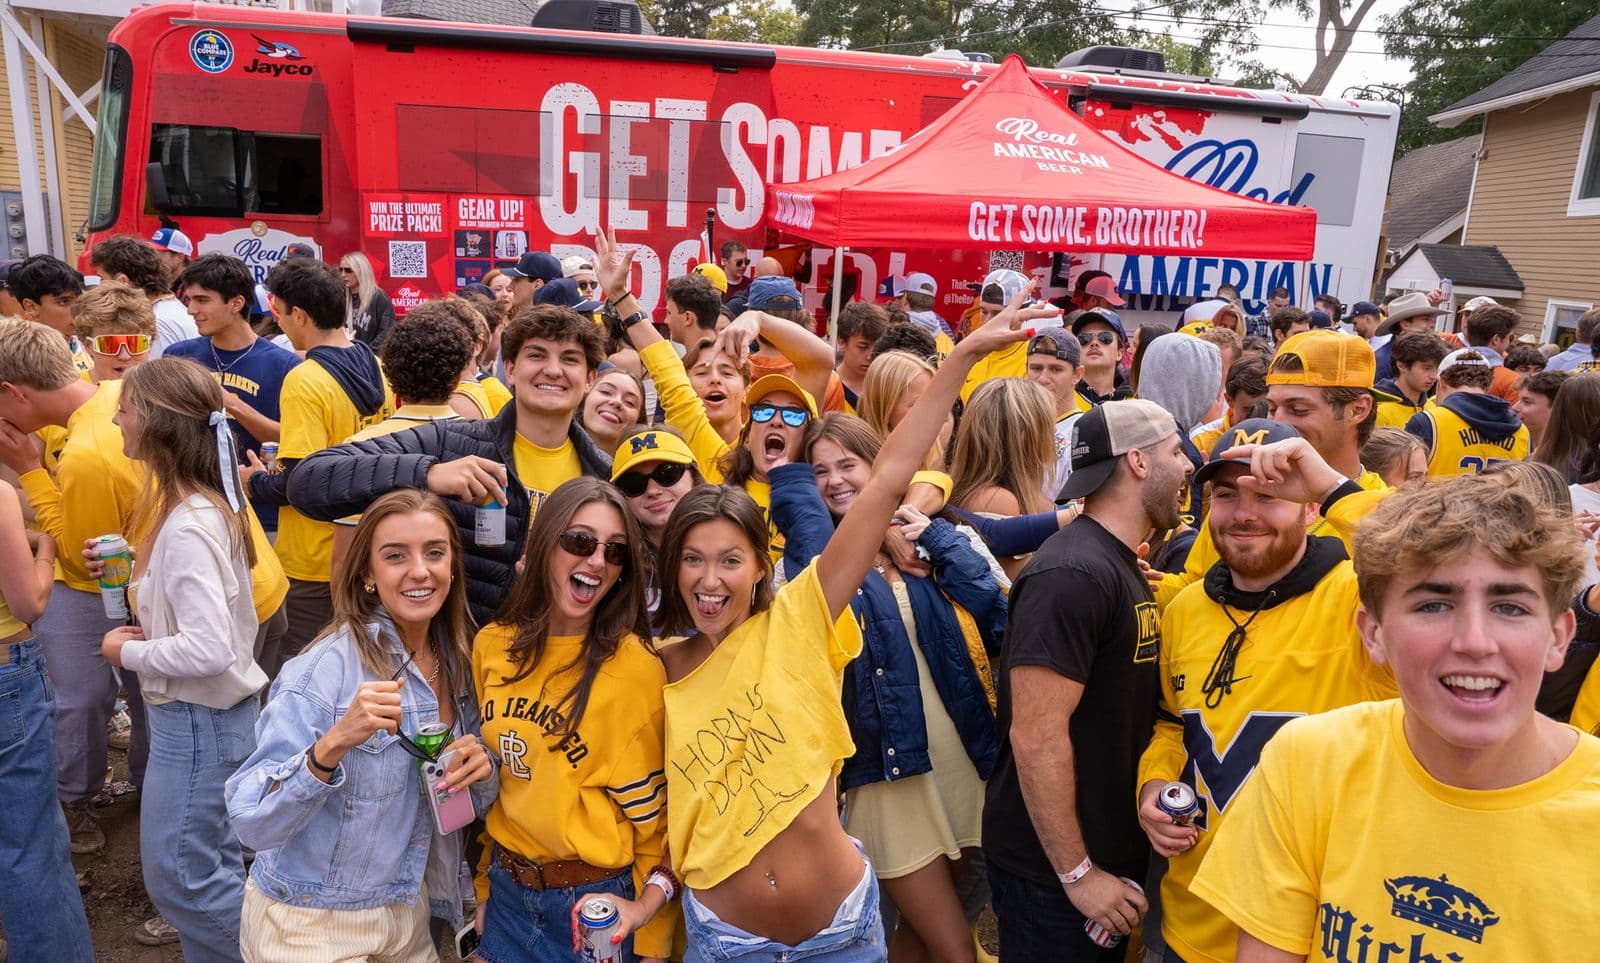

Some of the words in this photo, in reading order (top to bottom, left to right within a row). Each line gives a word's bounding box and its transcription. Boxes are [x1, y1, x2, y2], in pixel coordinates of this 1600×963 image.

[197, 48, 227, 56] COMPASS
[244, 59, 313, 77] Jayco
[995, 117, 1079, 147] Real
[540, 82, 707, 236] GET
[993, 142, 1112, 169] AMERICAN
[1037, 161, 1083, 175] BEER
[370, 202, 388, 214] WIN
[389, 202, 404, 215] THE
[405, 202, 442, 215] ULTIMATE
[459, 198, 495, 220] GEAR
[500, 199, 525, 221] UP!
[370, 214, 404, 231] PRIZE
[407, 215, 442, 232] PACK!
[967, 201, 1018, 242] GET
[1019, 204, 1091, 246] SOME,
[1096, 207, 1207, 248] BROTHER!
[233, 238, 288, 263] Real
[630, 433, 658, 454] M
[1233, 429, 1270, 447] M
[502, 697, 565, 733] JEANS
[703, 712, 787, 816] DOWN
